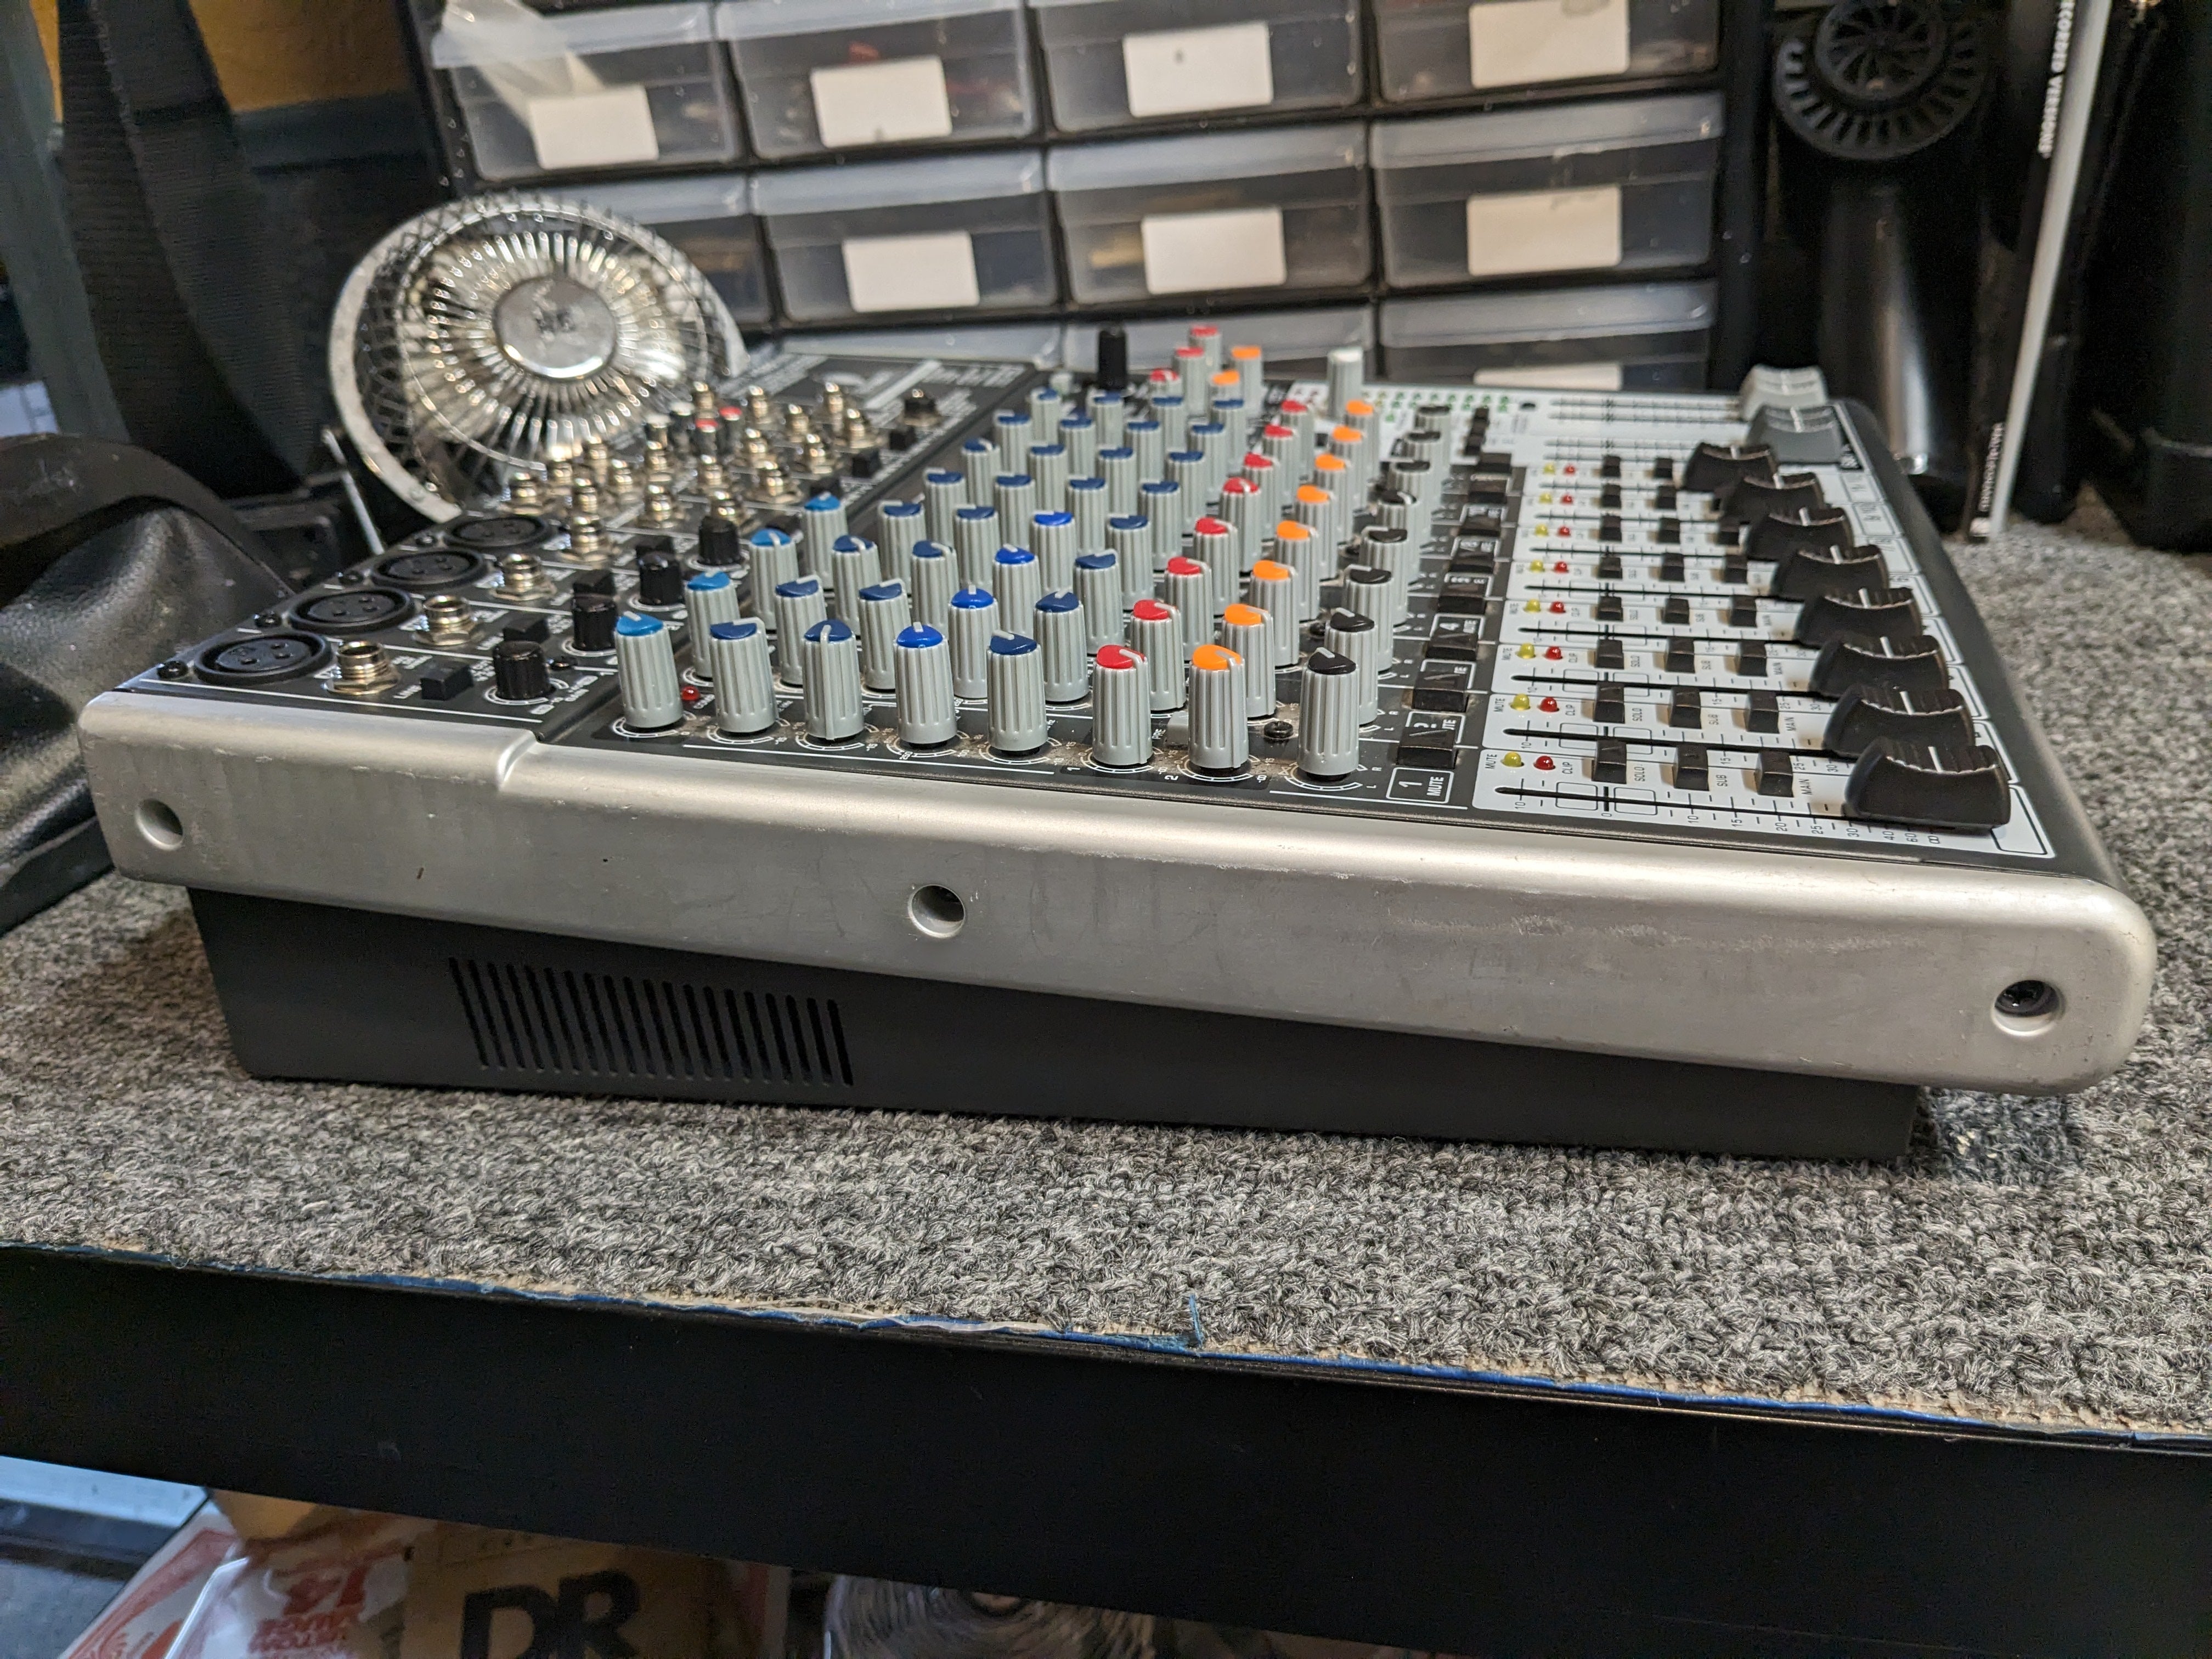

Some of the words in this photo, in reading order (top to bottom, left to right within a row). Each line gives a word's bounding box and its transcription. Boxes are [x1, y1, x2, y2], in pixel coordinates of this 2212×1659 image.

[2051, 0, 2075, 73] ECORDED
[1493, 697, 1505, 713] MUTE
[1565, 704, 1576, 716] CLIP
[1632, 708, 1643, 722] SOLO
[1784, 716, 1797, 732] MAIN
[1152, 728, 1166, 740] PRE
[1485, 753, 1498, 769] MUTE
[1720, 757, 1732, 765] 15
[1793, 762, 1805, 771] 25
[1561, 761, 1573, 775] CLIP
[1634, 766, 1645, 782] SOLO
[1426, 776, 1444, 797] MUTE
[1716, 774, 1728, 787] SUB
[1798, 778, 1813, 795] MAIN
[1514, 801, 1526, 810] 10
[1687, 815, 1699, 823] 10
[1731, 819, 1742, 827] 15
[1774, 822, 1788, 832] 20
[1810, 825, 1824, 835] 25
[1846, 828, 1860, 838] 30
[1882, 830, 1895, 840] 40
[1904, 833, 1918, 843] 60
